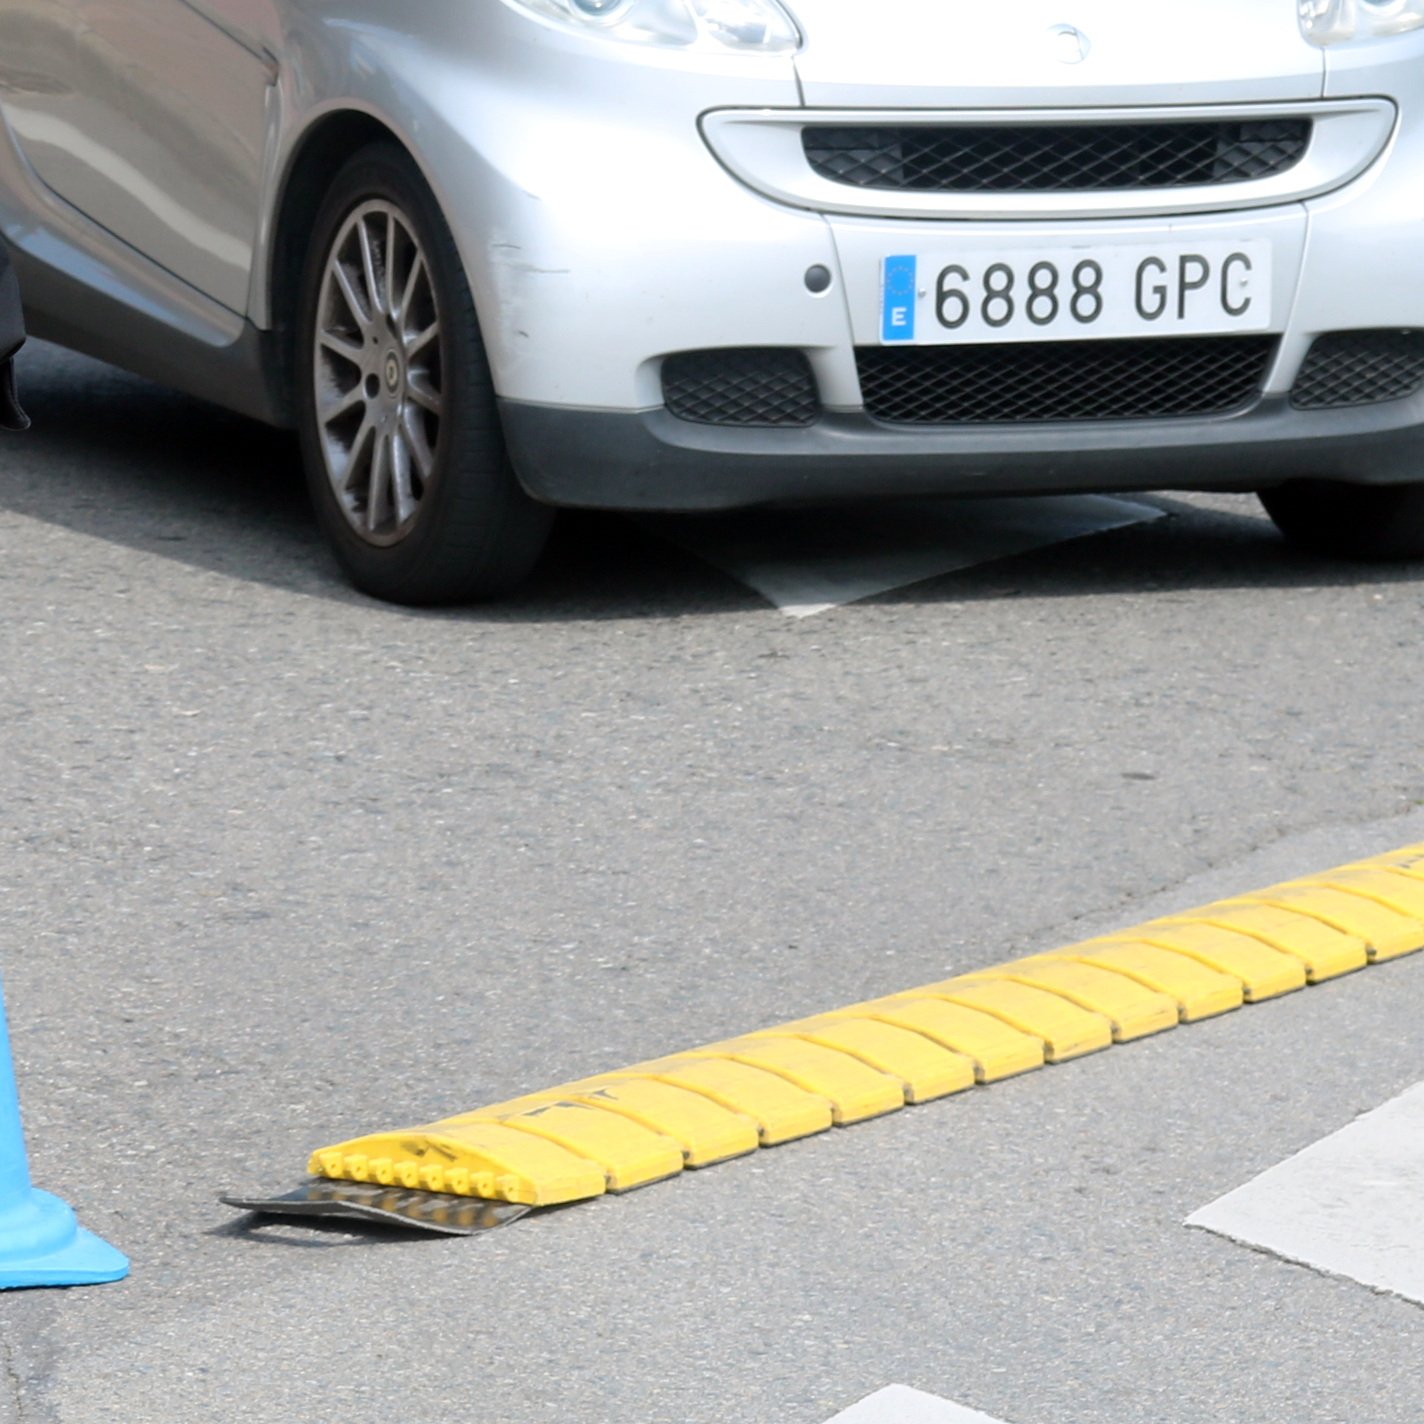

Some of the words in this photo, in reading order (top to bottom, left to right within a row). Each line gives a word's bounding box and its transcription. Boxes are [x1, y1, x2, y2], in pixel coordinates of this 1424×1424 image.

[934, 258, 1104, 330] 6888
[1134, 251, 1253, 322] GPC
[891, 307, 907, 327] E
